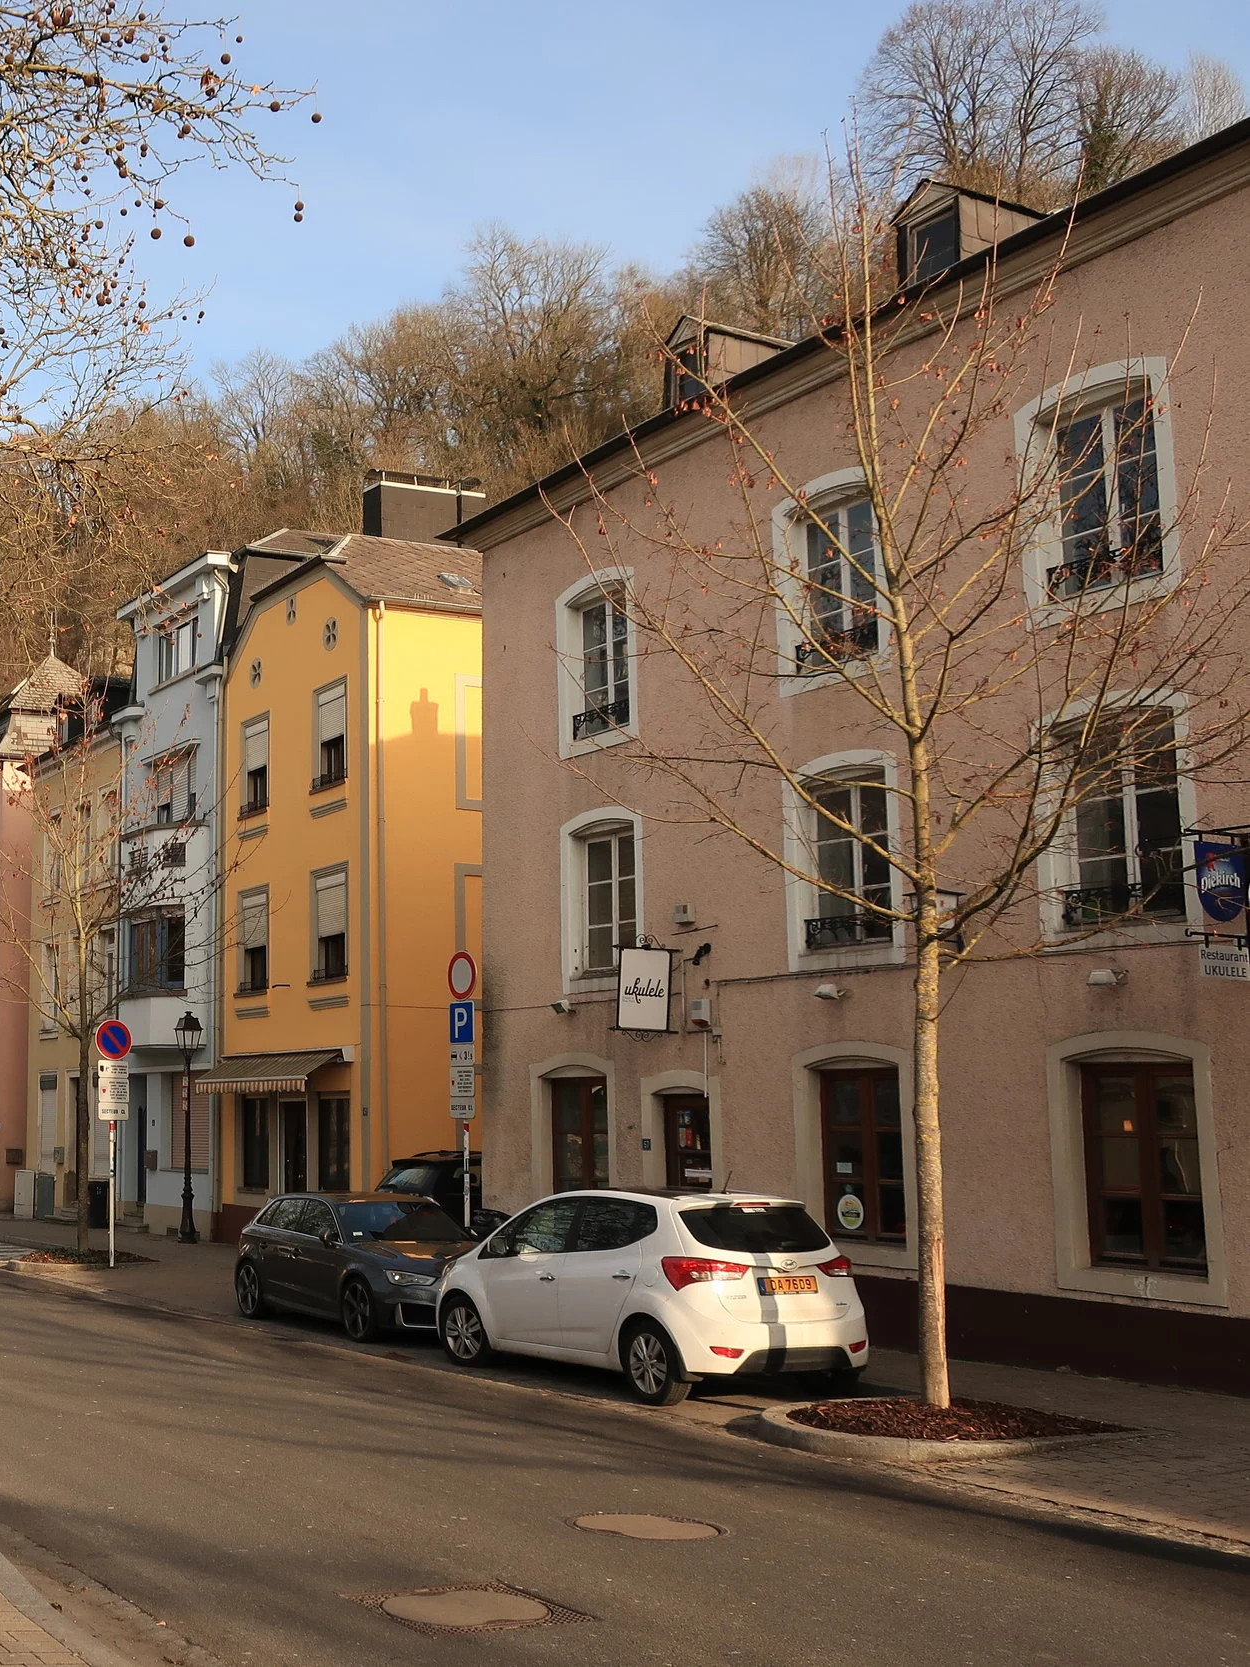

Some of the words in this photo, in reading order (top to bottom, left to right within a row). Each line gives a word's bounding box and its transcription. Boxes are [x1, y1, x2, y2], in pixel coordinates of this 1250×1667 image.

[1201, 870, 1241, 893] Diekirch
[1200, 949, 1249, 963] Restaurant
[1204, 964, 1247, 978] UKULELE
[624, 977, 665, 1005] ukulele
[454, 1007, 468, 1039] P
[786, 1279, 811, 1290] 7609
